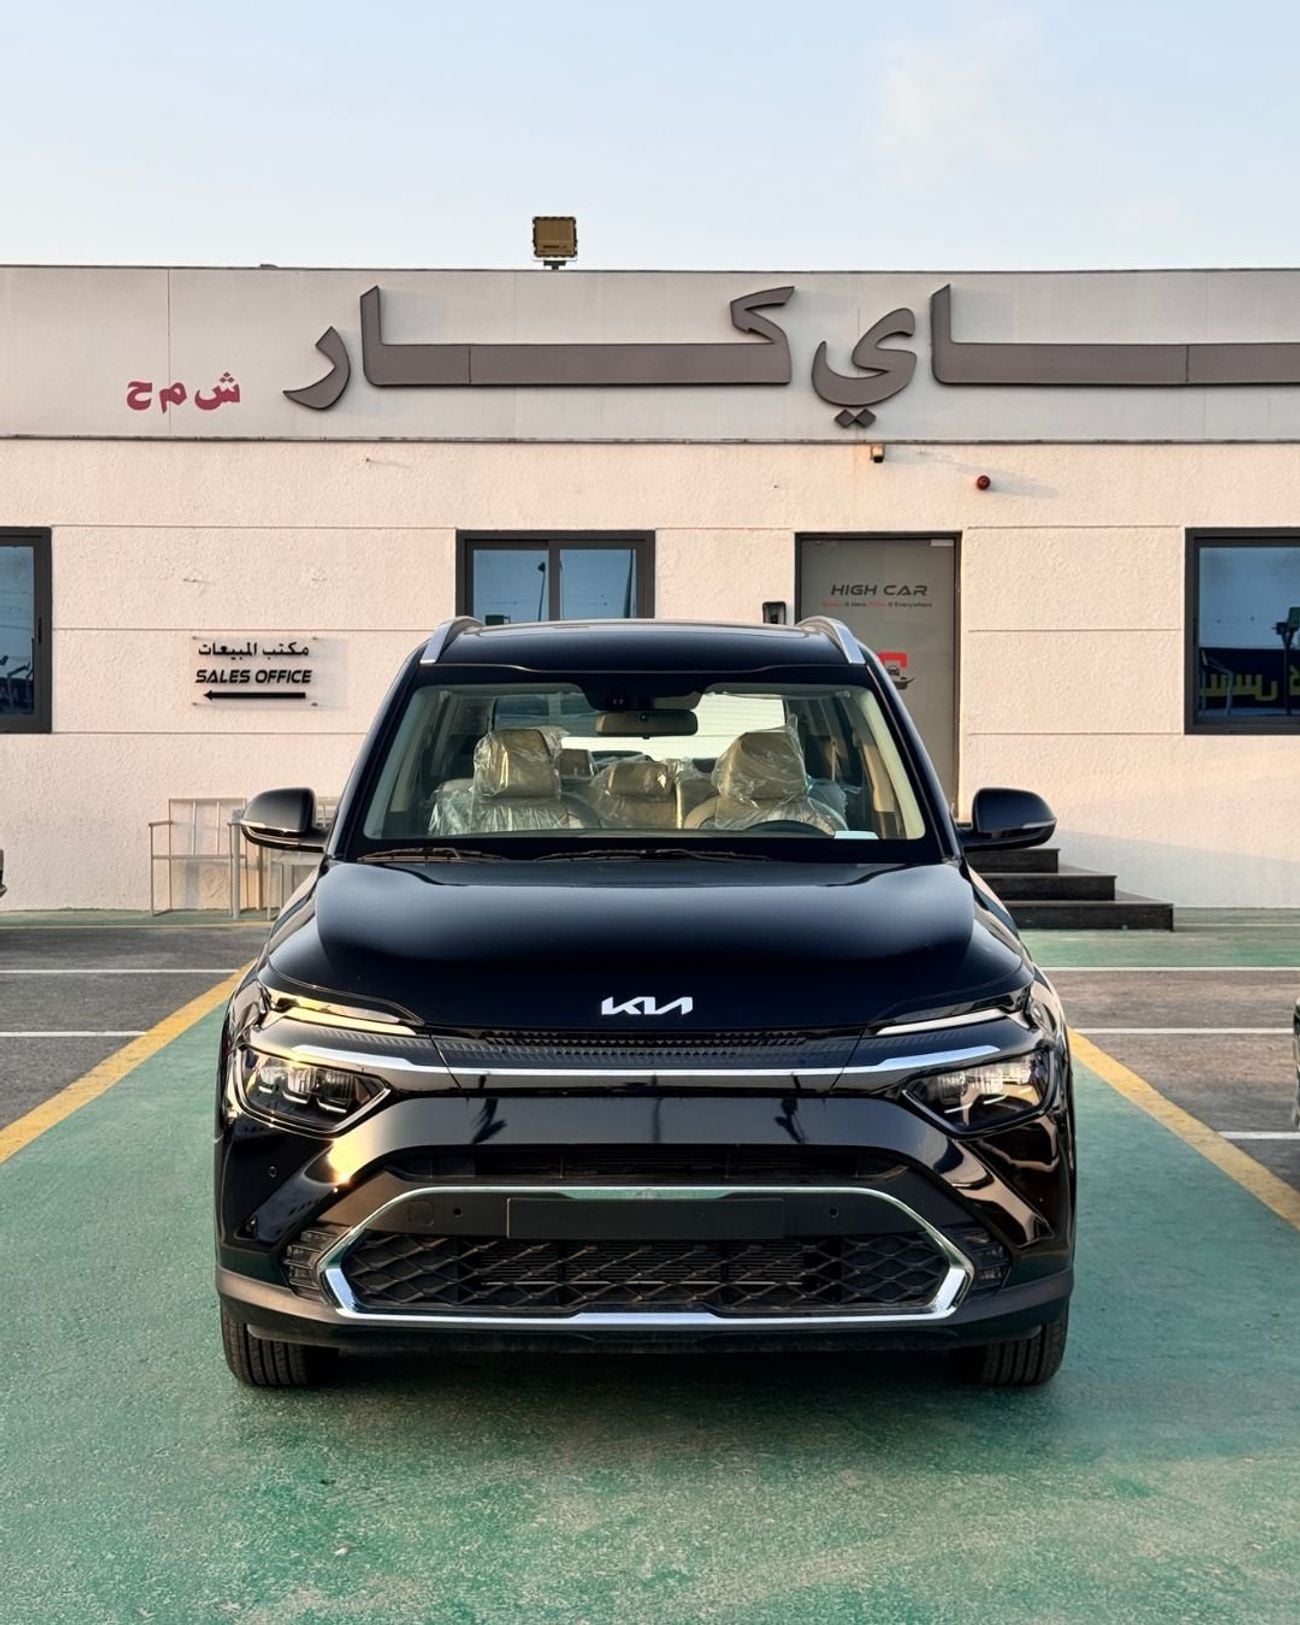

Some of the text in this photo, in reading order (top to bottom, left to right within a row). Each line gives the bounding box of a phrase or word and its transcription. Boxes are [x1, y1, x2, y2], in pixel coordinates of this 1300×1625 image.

[283, 283, 1300, 428] اي كار
[830, 584, 929, 596] HIGH CAR
[198, 641, 310, 661] مكتب المبيعات
[195, 669, 313, 684] SALES OFFICE
[601, 996, 693, 1015] KIA
